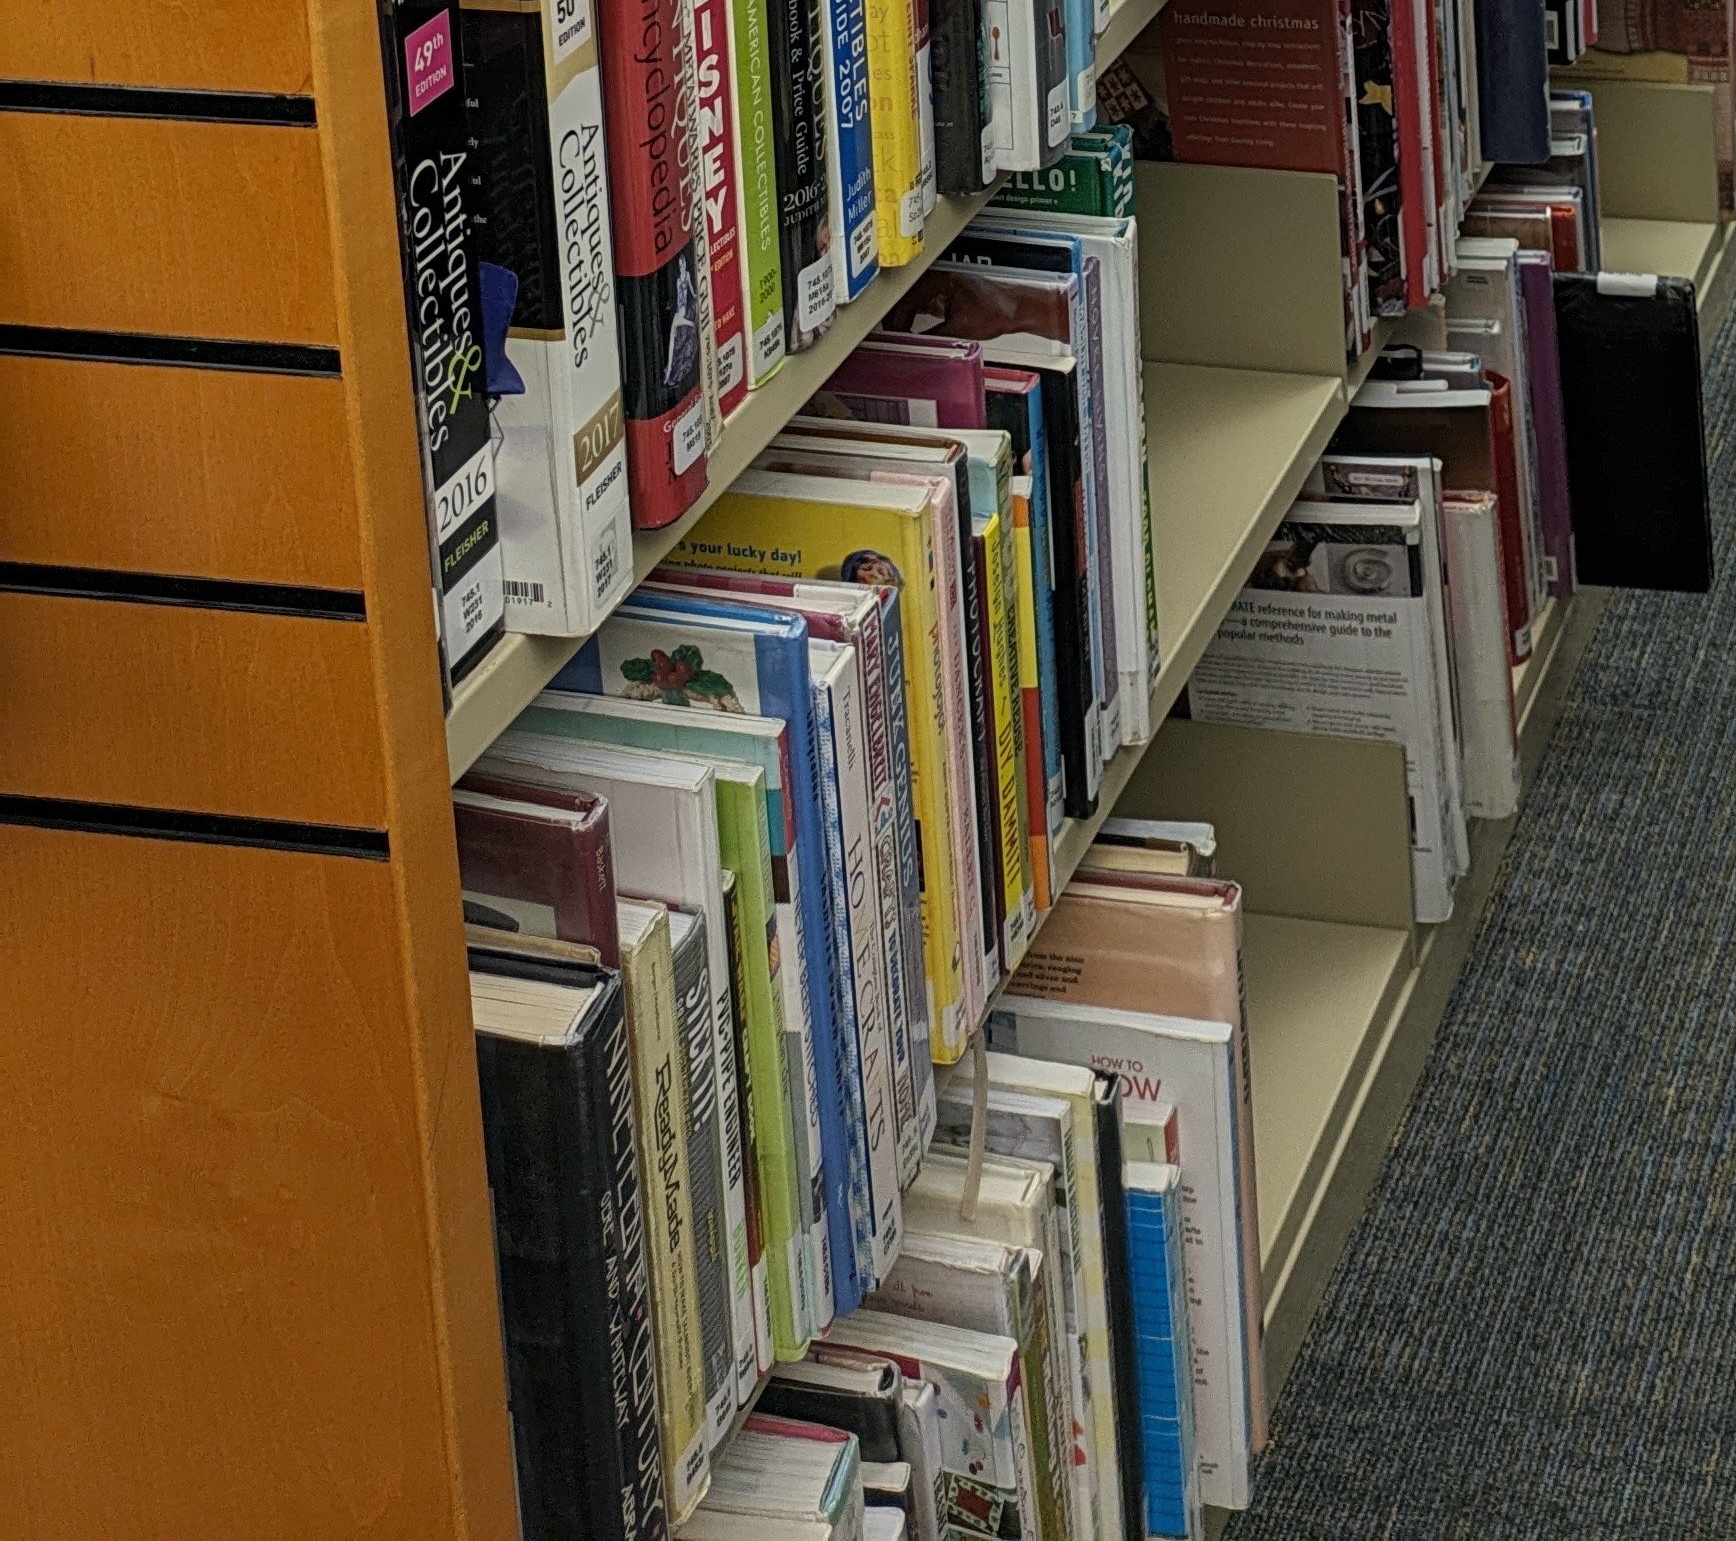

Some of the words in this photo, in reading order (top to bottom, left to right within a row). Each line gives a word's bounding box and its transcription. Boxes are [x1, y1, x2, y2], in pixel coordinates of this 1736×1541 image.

[558, 20, 586, 48] EDITION
[1174, 11, 1245, 28] handmade
[1250, 13, 1319, 30] christmas
[413, 32, 444, 73] 49th
[415, 65, 448, 100] EDITION
[790, 49, 801, 63] &
[792, 71, 806, 117] Price
[838, 58, 855, 129] 2007
[796, 121, 809, 176] Guide
[580, 122, 607, 288] Antiques
[752, 108, 770, 251] COLLECTIBLES
[440, 150, 475, 357] Antiques
[559, 131, 588, 368] Collectibles
[409, 157, 449, 453] Collectibles
[591, 280, 610, 337] &
[448, 344, 482, 415] &
[579, 403, 622, 471] 2017
[437, 466, 488, 532] 2016
[585, 462, 622, 511] FLEISHER
[443, 520, 490, 573] FLEISHER
[1217, 628, 1256, 641] popular
[1258, 632, 1304, 645] methods
[1249, 619, 1326, 634] comprehensive
[1330, 624, 1358, 637] guide
[1361, 626, 1372, 637] to
[1374, 626, 1392, 638] the
[1258, 603, 1305, 618] reference
[1308, 606, 1322, 620] for
[1325, 609, 1364, 624] making
[1366, 611, 1397, 624] metal
[888, 630, 907, 742] JUNK
[894, 746, 912, 888] GENIUS
[716, 985, 736, 1095] PVC-PIPE
[1091, 1054, 1113, 1070] HOW
[1117, 1058, 1144, 1073] TO
[655, 1053, 684, 1253] ReadyMade
[723, 1095, 742, 1191] ENGINEER
